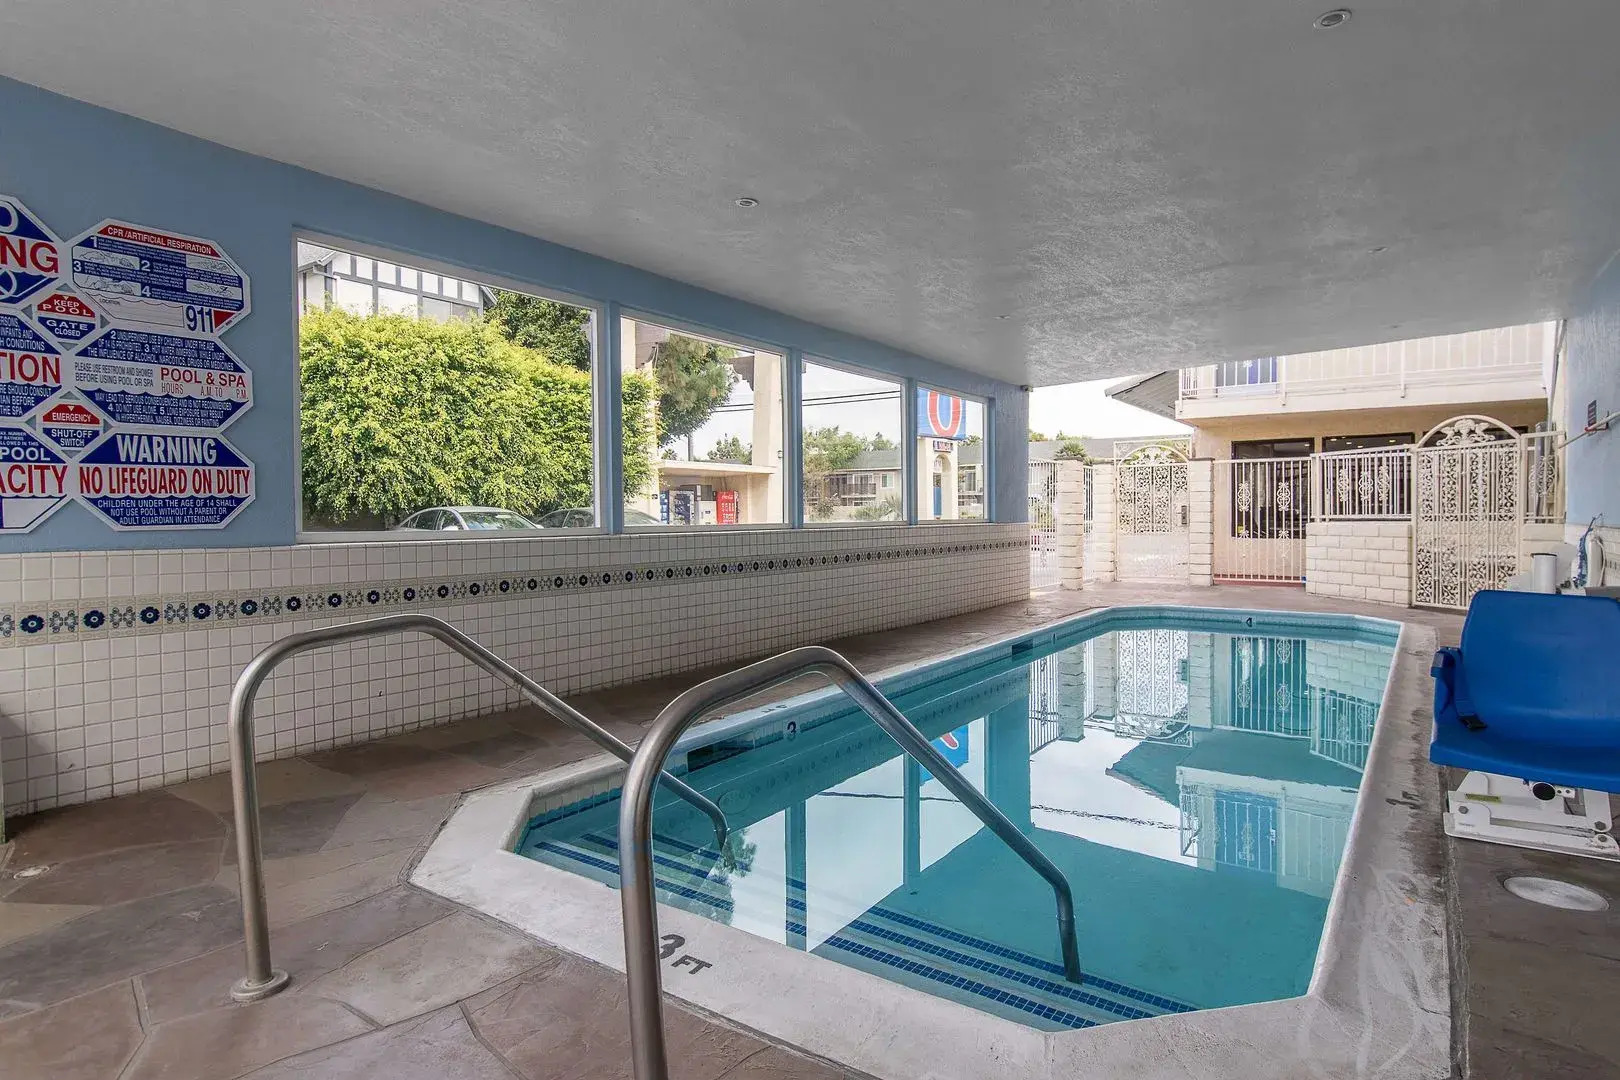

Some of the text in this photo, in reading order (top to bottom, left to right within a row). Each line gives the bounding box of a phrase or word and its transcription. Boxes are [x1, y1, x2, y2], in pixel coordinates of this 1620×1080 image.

[90, 236, 97, 247] 1
[108, 227, 123, 237] CPR
[167, 240, 211, 254] RESPIRATION
[74, 261, 81, 272] 3
[141, 260, 150, 272] 2
[142, 286, 151, 297] 4
[54, 299, 80, 307] KEEP
[42, 304, 91, 316] POOL
[46, 320, 88, 330] GATE
[186, 305, 214, 333] 911
[1, 327, 33, 339] INFANTS AND
[55, 328, 80, 337] CLOSED
[6, 338, 45, 351] CONDITIONS
[117, 331, 148, 343] UNSUPERVISED
[164, 337, 184, 347] CHILDREN
[185, 339, 198, 348] UNDER
[98, 339, 104, 347] OF
[111, 340, 115, 349] IS
[152, 345, 160, 353] HOT
[161, 346, 174, 355] WATER
[212, 352, 224, 361] UNDER
[88, 347, 97, 357] THE
[98, 348, 126, 360] INFLUENCE
[127, 351, 133, 360] OF
[187, 358, 203, 368] DRUGS
[204, 360, 210, 368] OR
[211, 360, 233, 370] MEDICINES
[75, 362, 92, 372] PLEASE
[102, 364, 125, 375] RESTROOM
[126, 367, 135, 376] AND
[136, 368, 153, 377] SHOWER
[75, 373, 154, 387] BEFORE USING POOL OR SPA
[161, 368, 245, 388] POOL & SPA
[8, 385, 28, 396] SHOULD
[30, 387, 51, 397] CONSULT
[162, 383, 183, 394] HOURS
[215, 387, 222, 398] TO
[236, 389, 248, 400] P.M.
[12, 396, 35, 406] BEFORE
[95, 392, 104, 401] MAY
[106, 393, 117, 402] LEAD
[118, 394, 124, 403] TO
[125, 395, 144, 404] SERIOUS
[145, 396, 178, 406] CONSEQUENCES
[193, 400, 201, 408] NOT
[202, 400, 232, 411] RECOMMENDED
[0, 405, 23, 416] THE SPA
[115, 404, 122, 412] DO
[123, 404, 132, 412] NOT
[133, 405, 142, 413] USE
[167, 407, 178, 416] LONG
[179, 408, 199, 417] EXPOSURE
[209, 410, 224, 419] RESULT
[52, 413, 91, 422] EMERGENCY
[174, 416, 194, 426] DIZZINESS
[195, 418, 200, 426] OR
[201, 418, 219, 427] FAINTING
[52, 429, 92, 438] SHUT-OFF
[61, 438, 84, 447] SWITCH
[0, 447, 51, 461] POOL
[116, 434, 216, 464] WARNING
[79, 466, 250, 494] NO LIFEGUARD ON DUTY
[98, 500, 136, 508] CHILDREN
[138, 500, 163, 508] UNDER
[165, 500, 179, 508] THE
[119, 516, 140, 525] ADULT
[141, 516, 174, 524] GUARDIAN
[183, 515, 221, 524] ATTENDANCE
[660, 934, 713, 975] 3 FT
